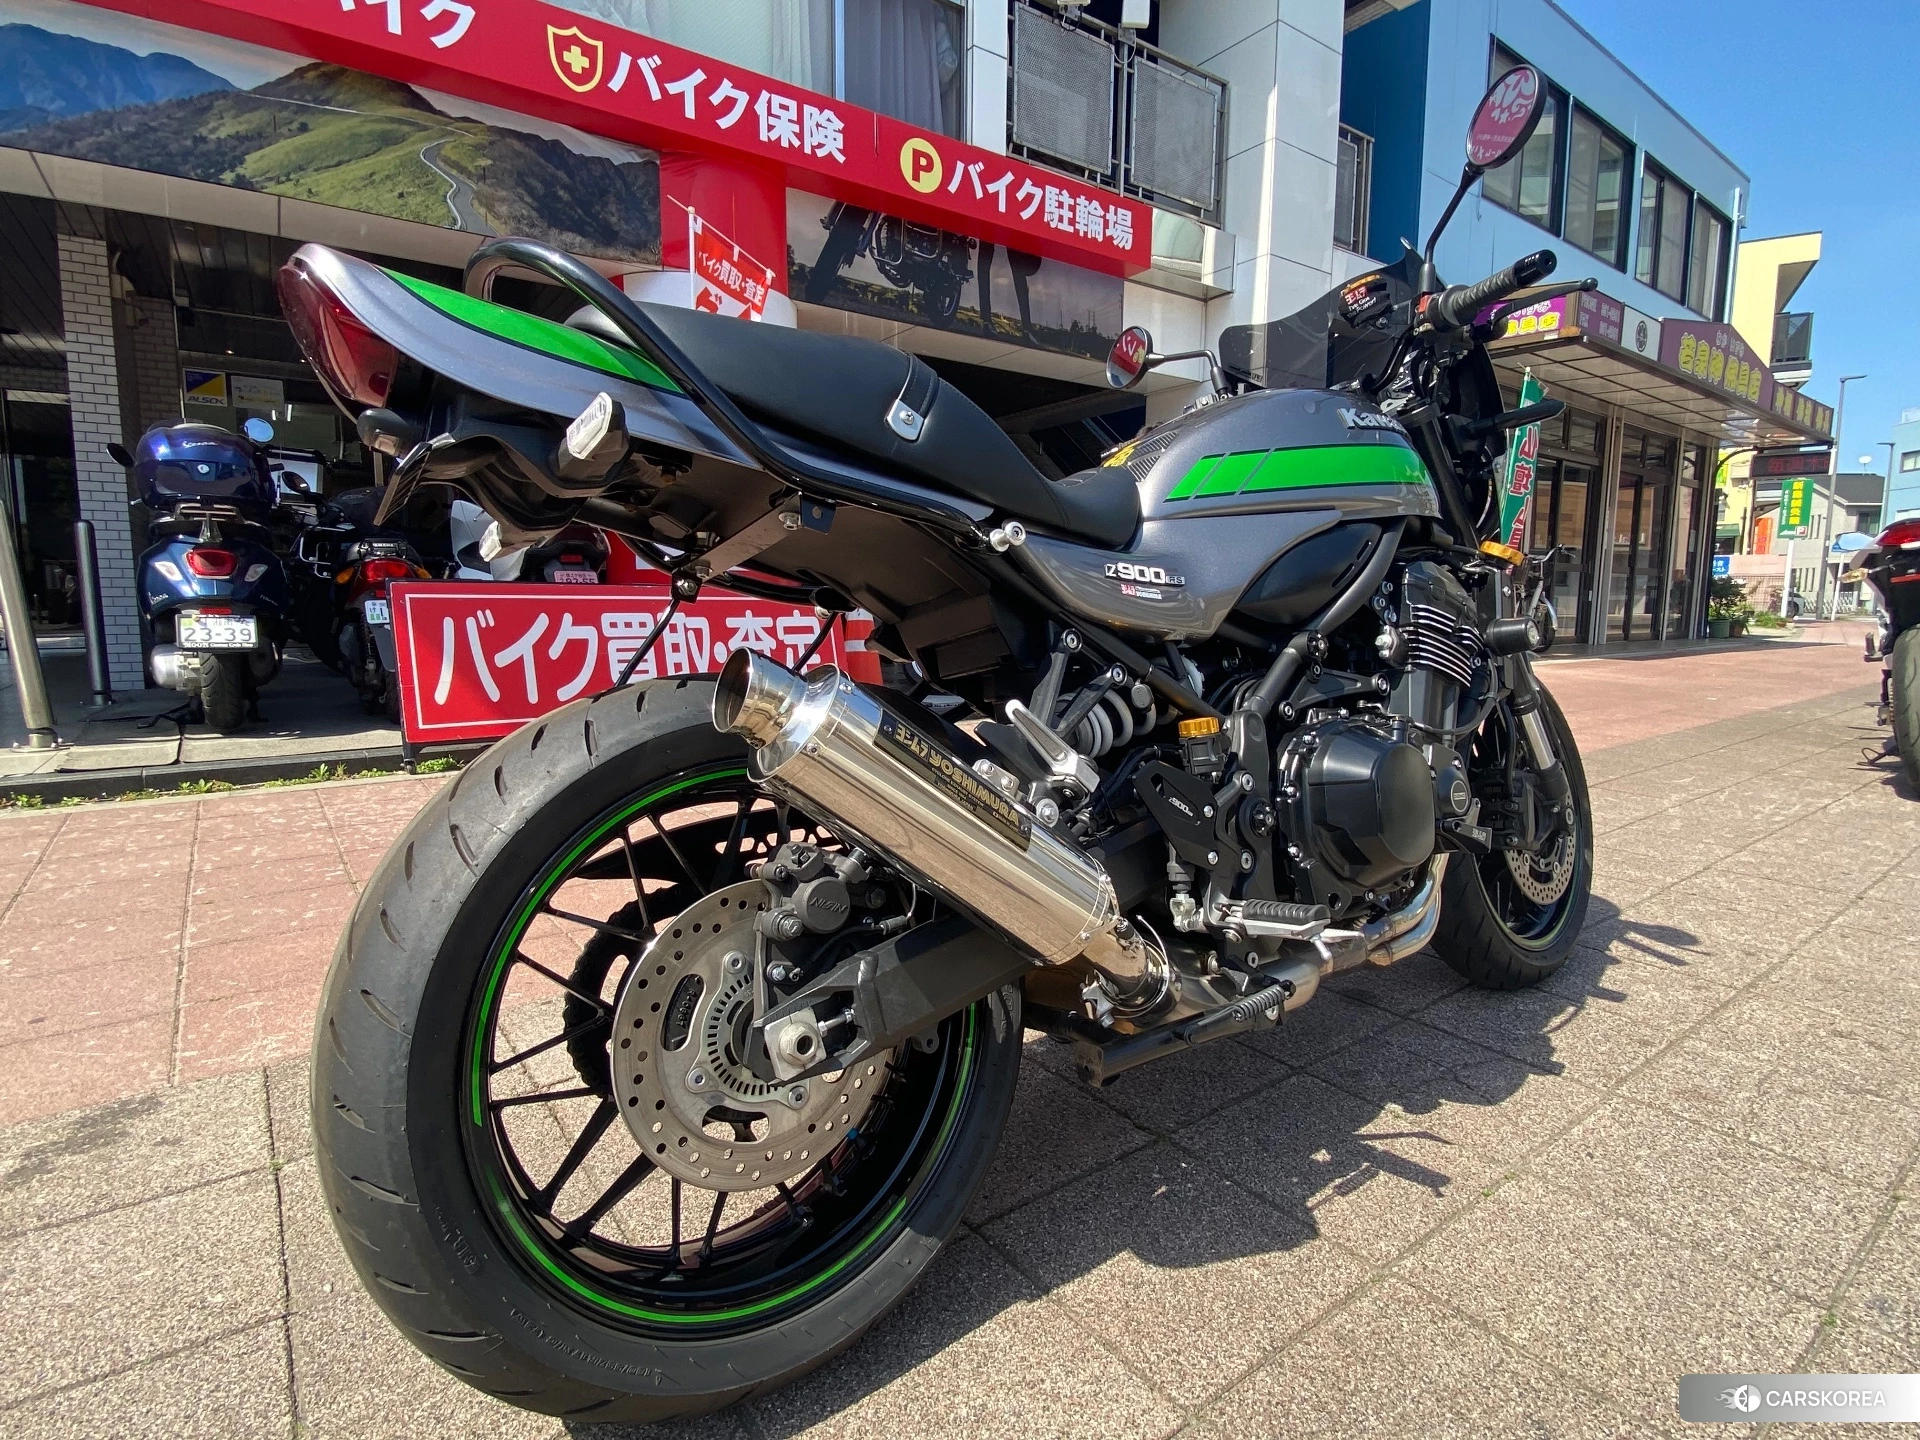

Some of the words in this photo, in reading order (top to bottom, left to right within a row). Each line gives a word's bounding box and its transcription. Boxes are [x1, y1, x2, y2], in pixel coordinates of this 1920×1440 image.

[608, 50, 846, 164] バイク保険
[947, 159, 1133, 250] バイク駐輪場
[699, 251, 765, 307] バイク買取・査定
[184, 627, 252, 642] 23-39
[434, 608, 821, 705] バイク買取・査定
[928, 749, 1020, 825] YOSHIMURA
